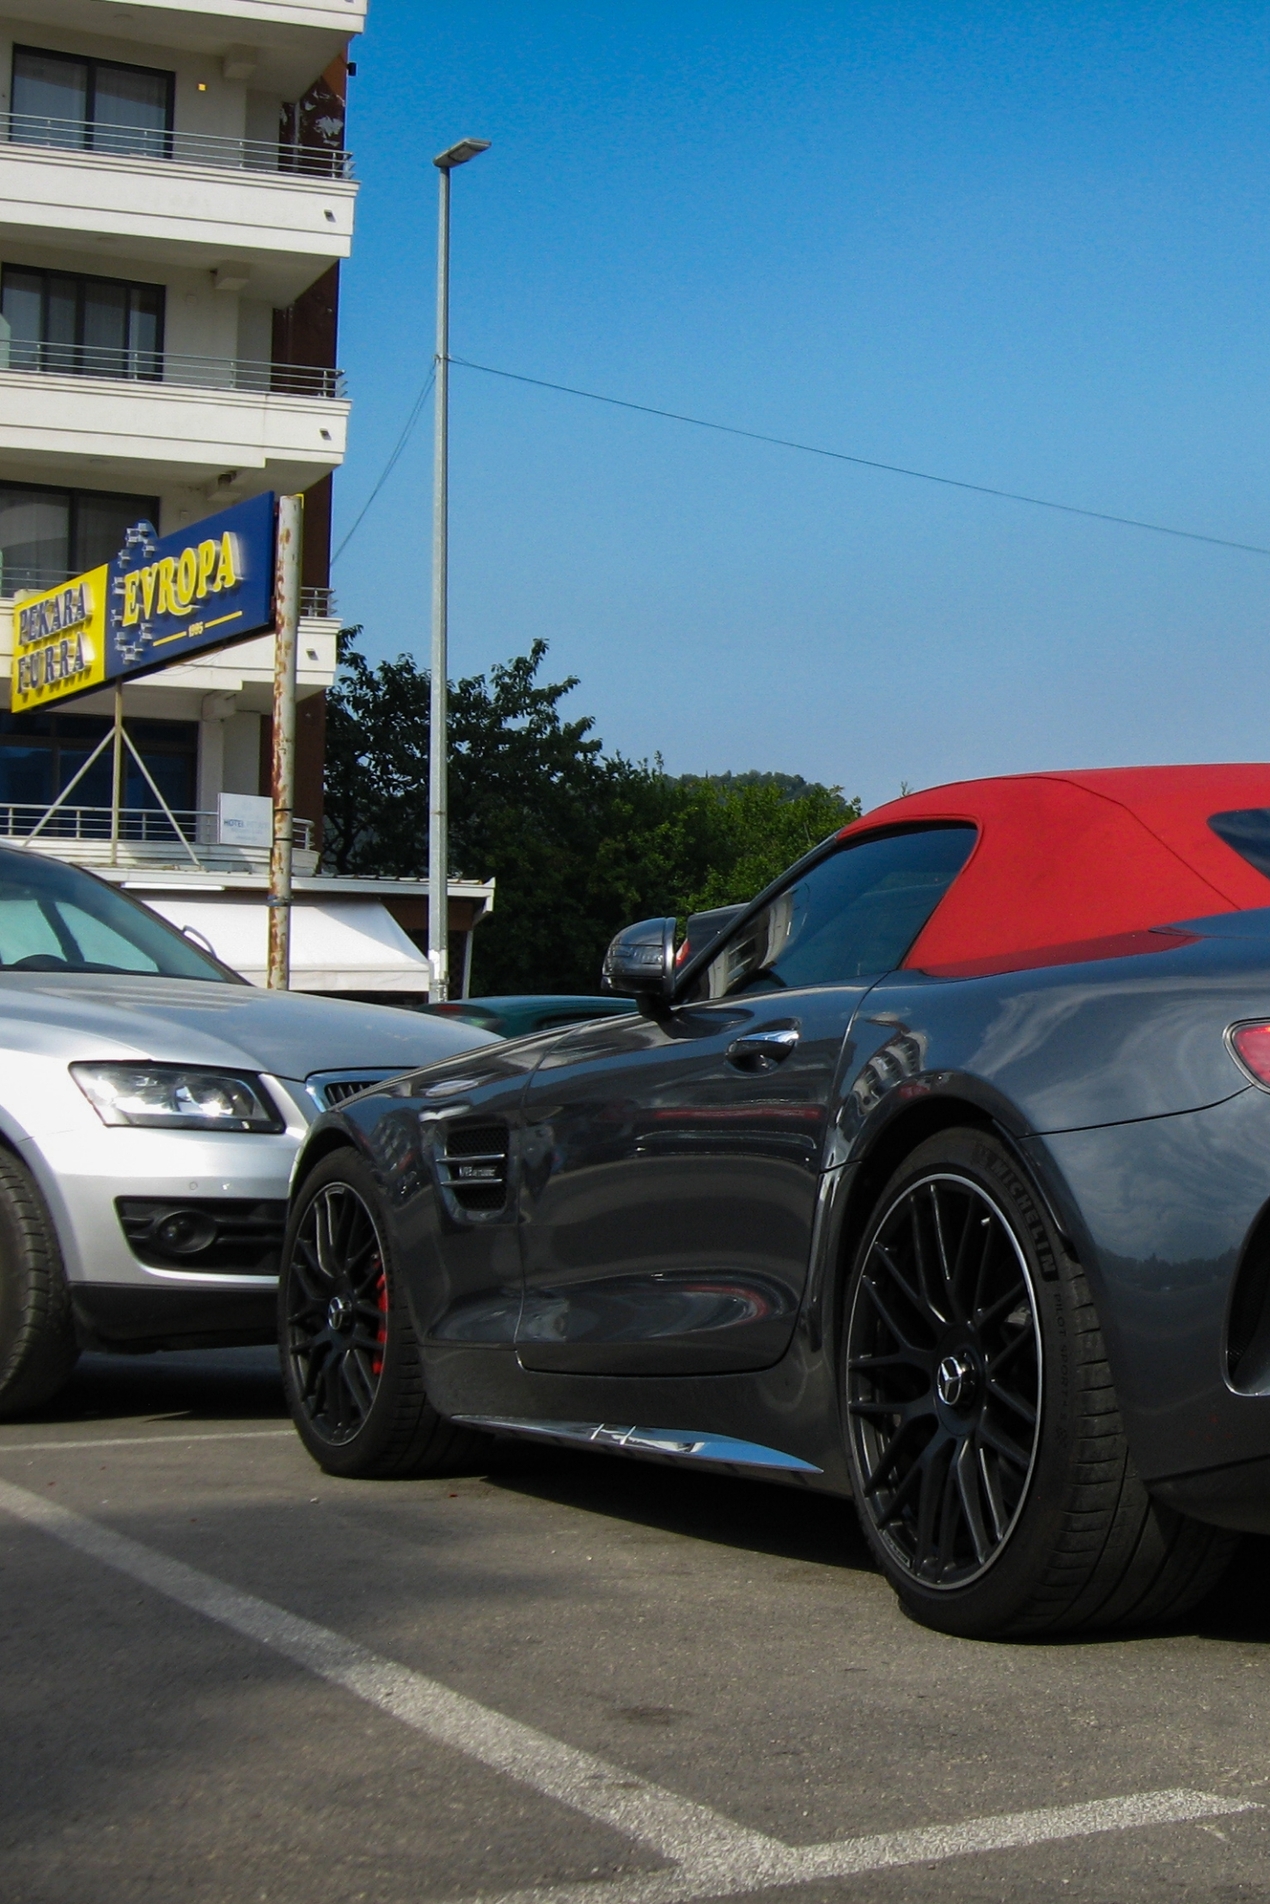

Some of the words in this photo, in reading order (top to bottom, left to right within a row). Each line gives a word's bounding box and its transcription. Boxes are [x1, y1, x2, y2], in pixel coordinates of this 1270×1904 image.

[122, 531, 240, 627] EVROPA
[19, 582, 90, 646] PEKARA
[17, 632, 90, 694] FURRA
[223, 818, 244, 828] HOTEL
[989, 1157, 1057, 1273] MICHELIN
